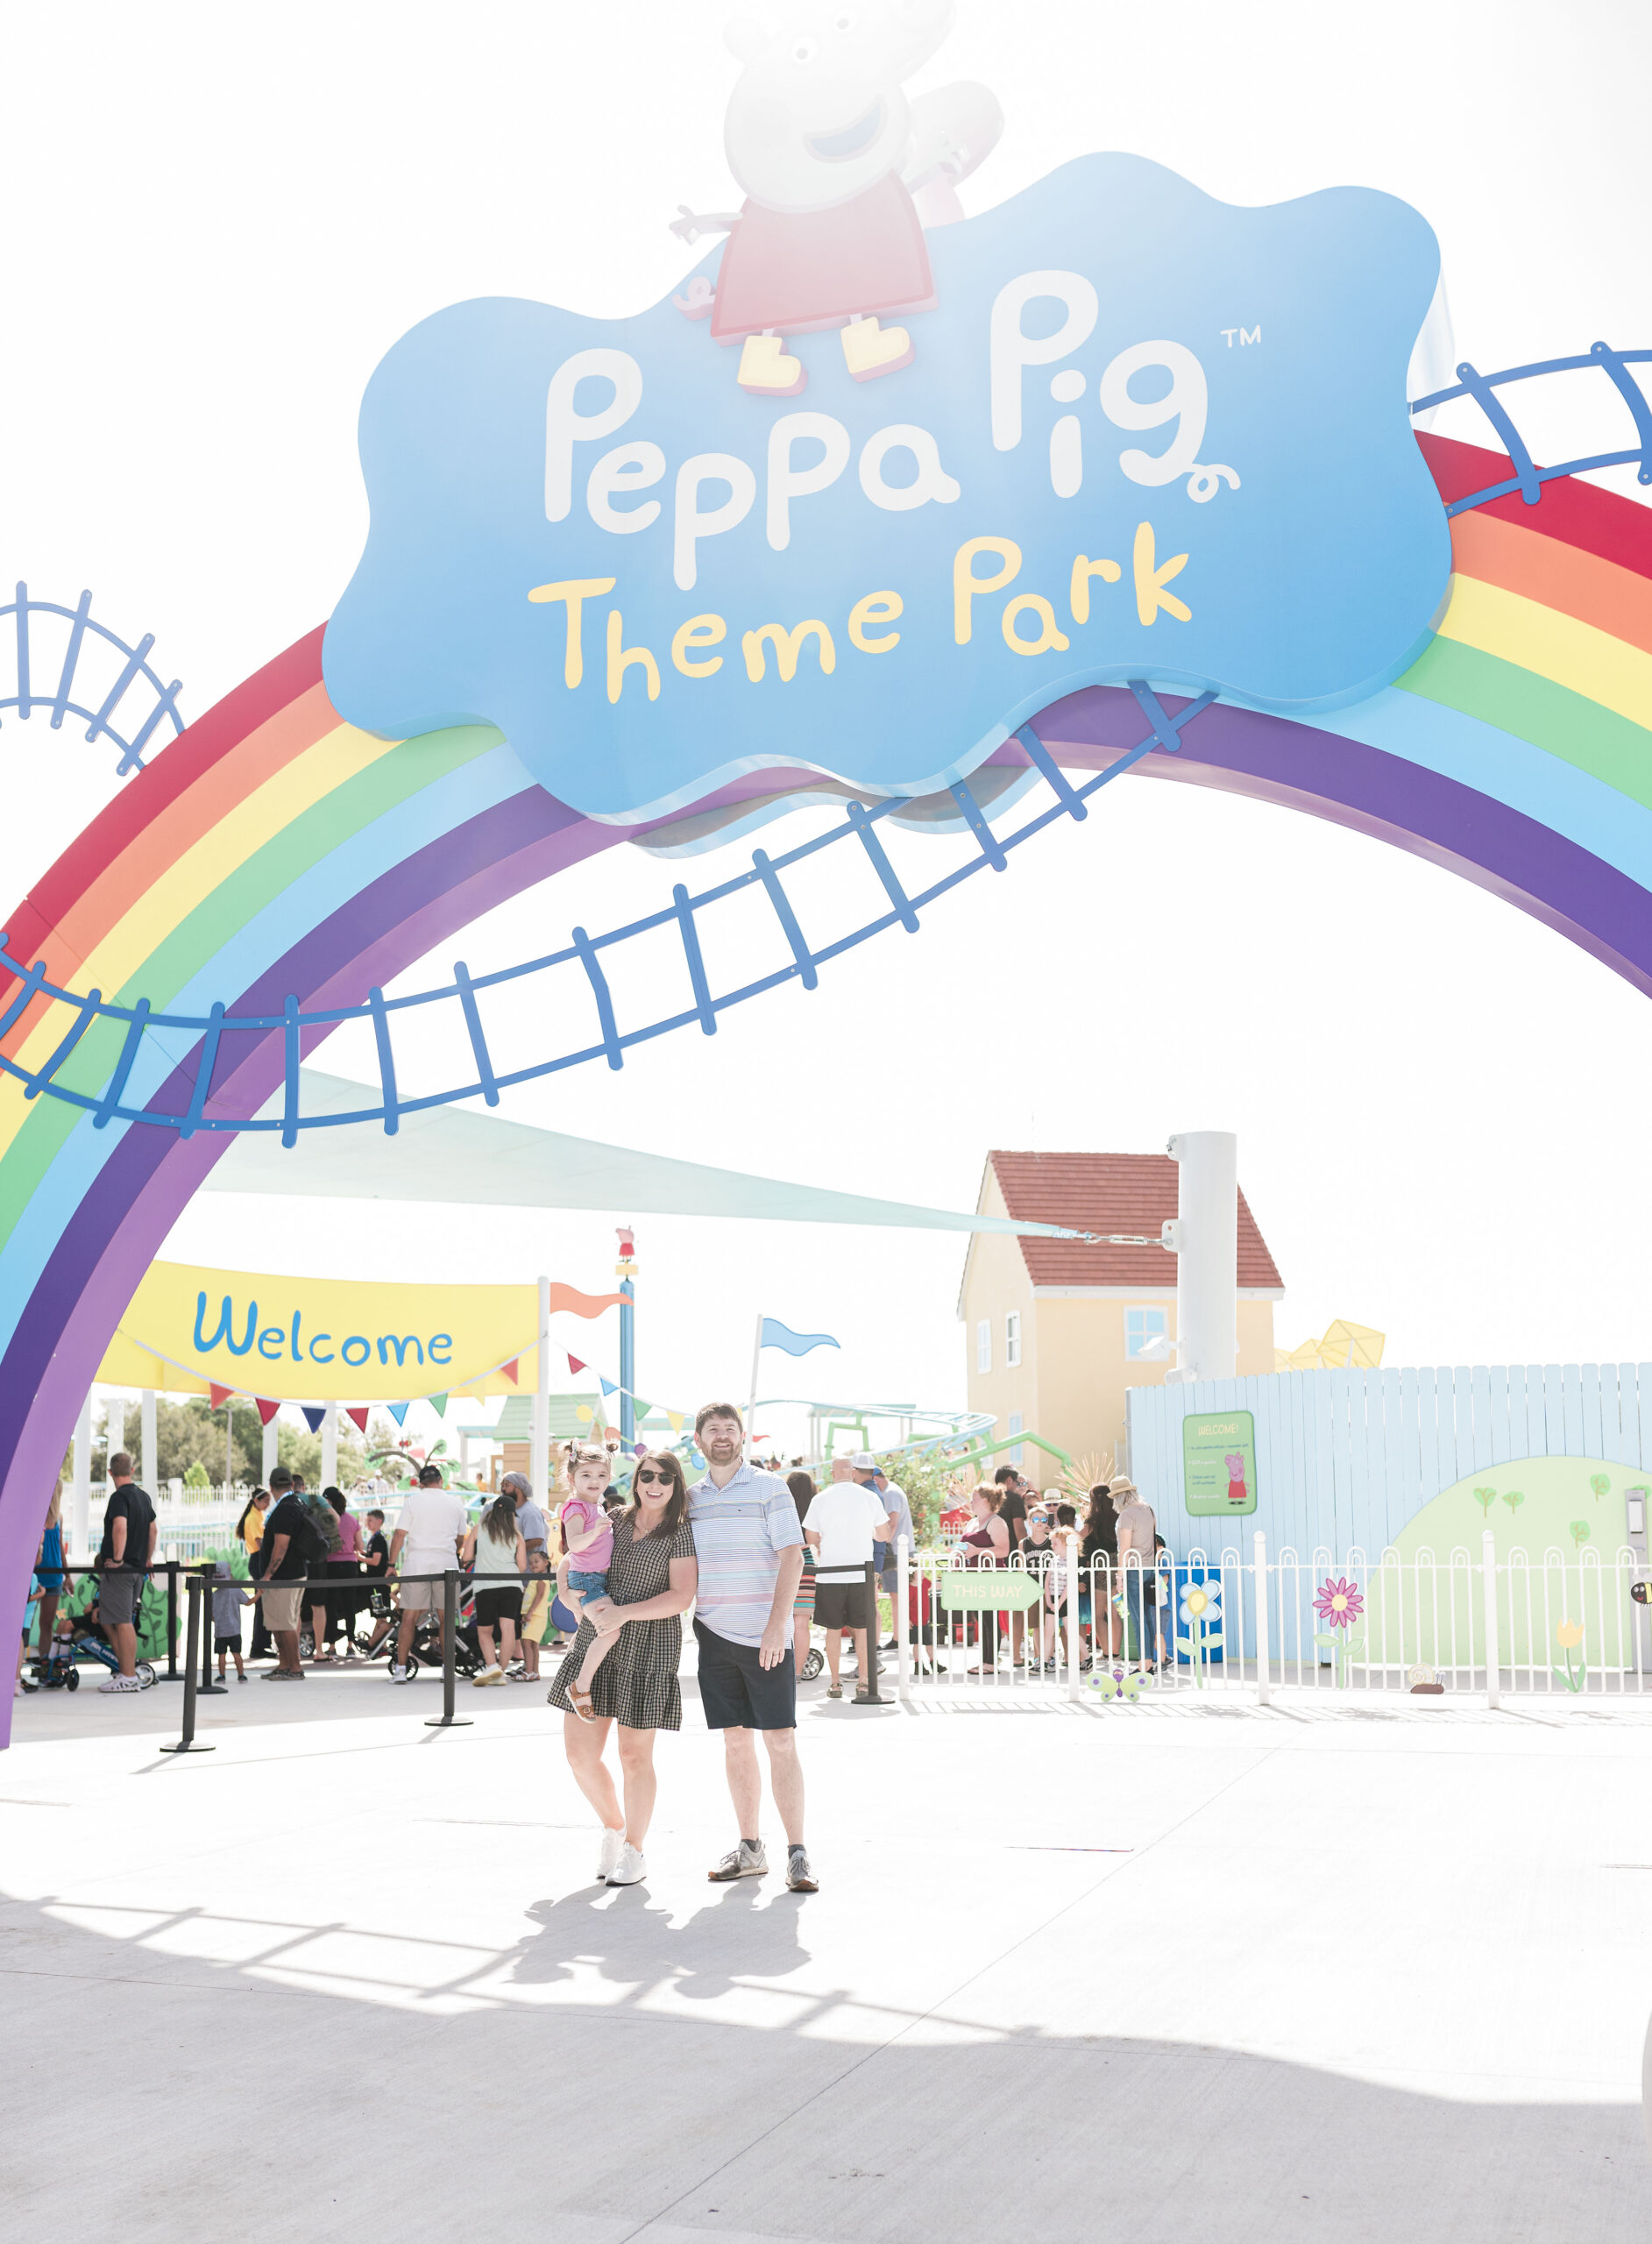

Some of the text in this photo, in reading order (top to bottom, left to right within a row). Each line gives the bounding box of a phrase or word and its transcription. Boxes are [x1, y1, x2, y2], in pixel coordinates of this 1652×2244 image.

[544, 347, 961, 591] Peppa
[990, 269, 1242, 505] Pig
[528, 521, 1194, 705] Theme Park
[193, 1290, 453, 1367] Welcome
[1197, 1423, 1238, 1436] WELCOME!
[952, 1584, 1024, 1598] THIS WAY
